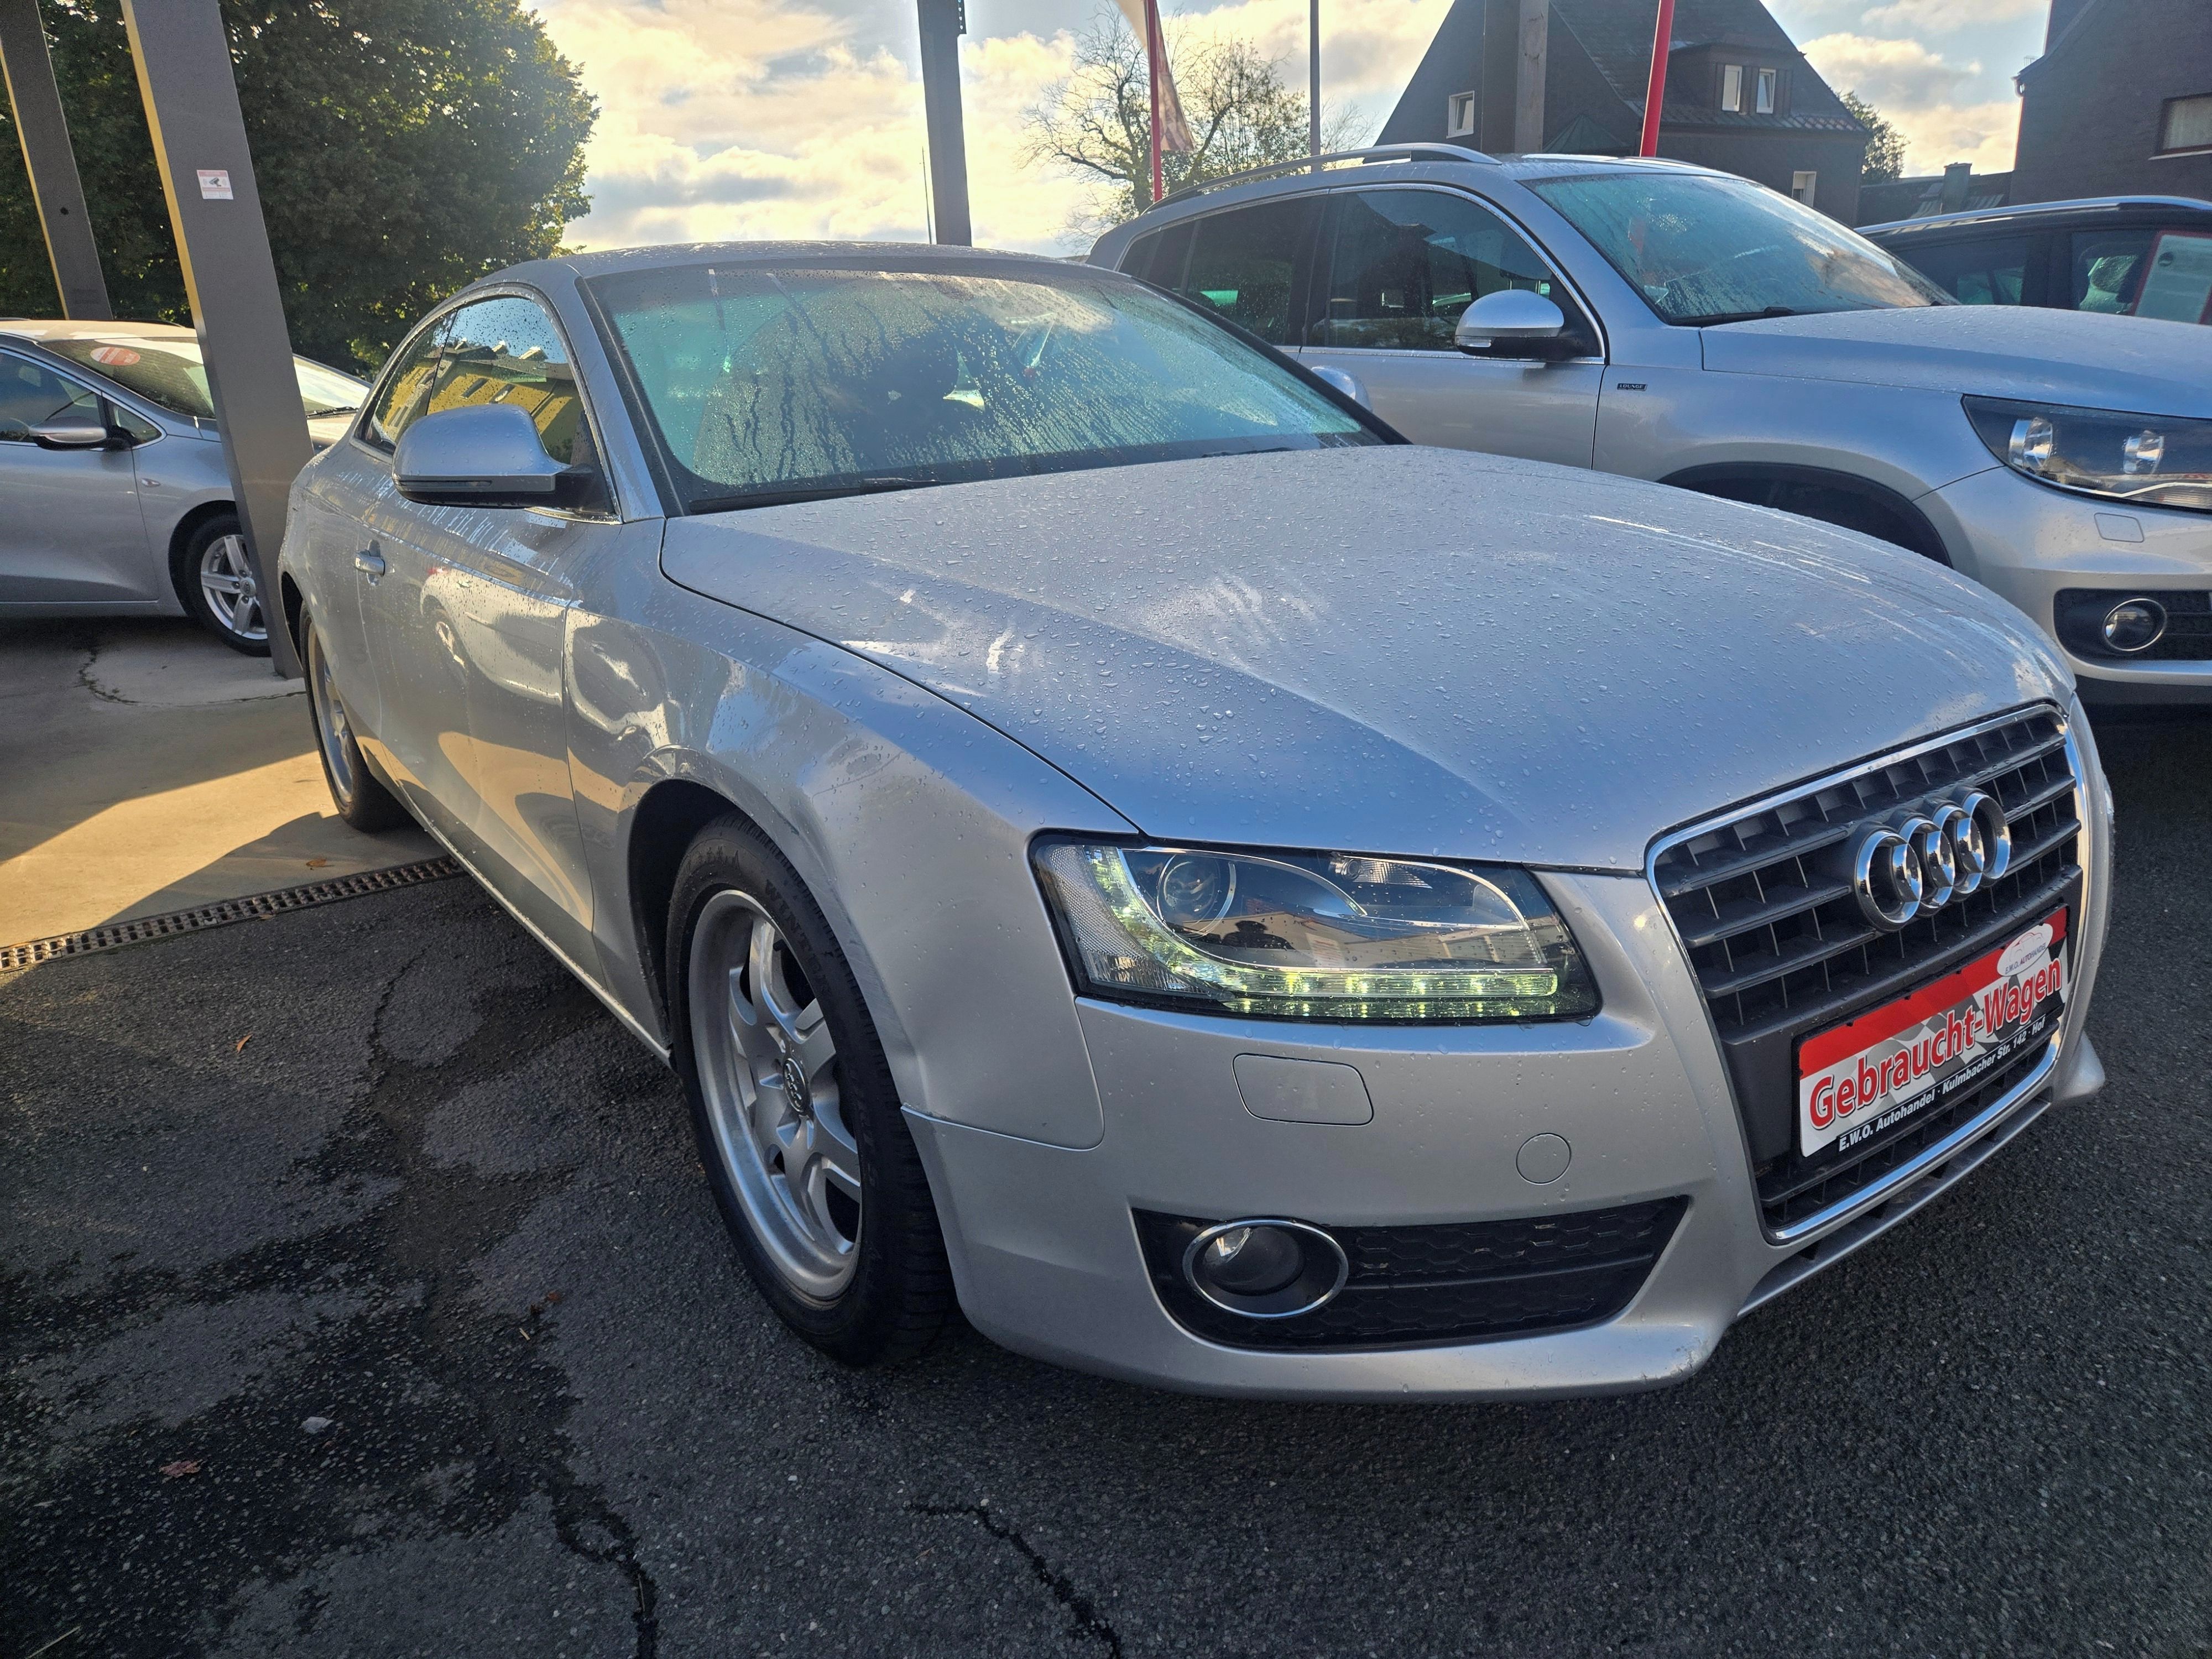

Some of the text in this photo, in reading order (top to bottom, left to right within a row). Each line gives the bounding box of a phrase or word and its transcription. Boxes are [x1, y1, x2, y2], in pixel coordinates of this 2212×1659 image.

[2020, 942, 2046, 966] AUTOHANDEL
[1809, 958, 2062, 1129] Gebraucht-Wagen
[1839, 1017, 2046, 1152] E.W.O. Autohandel Kulmbacher Str. 142 Hof
